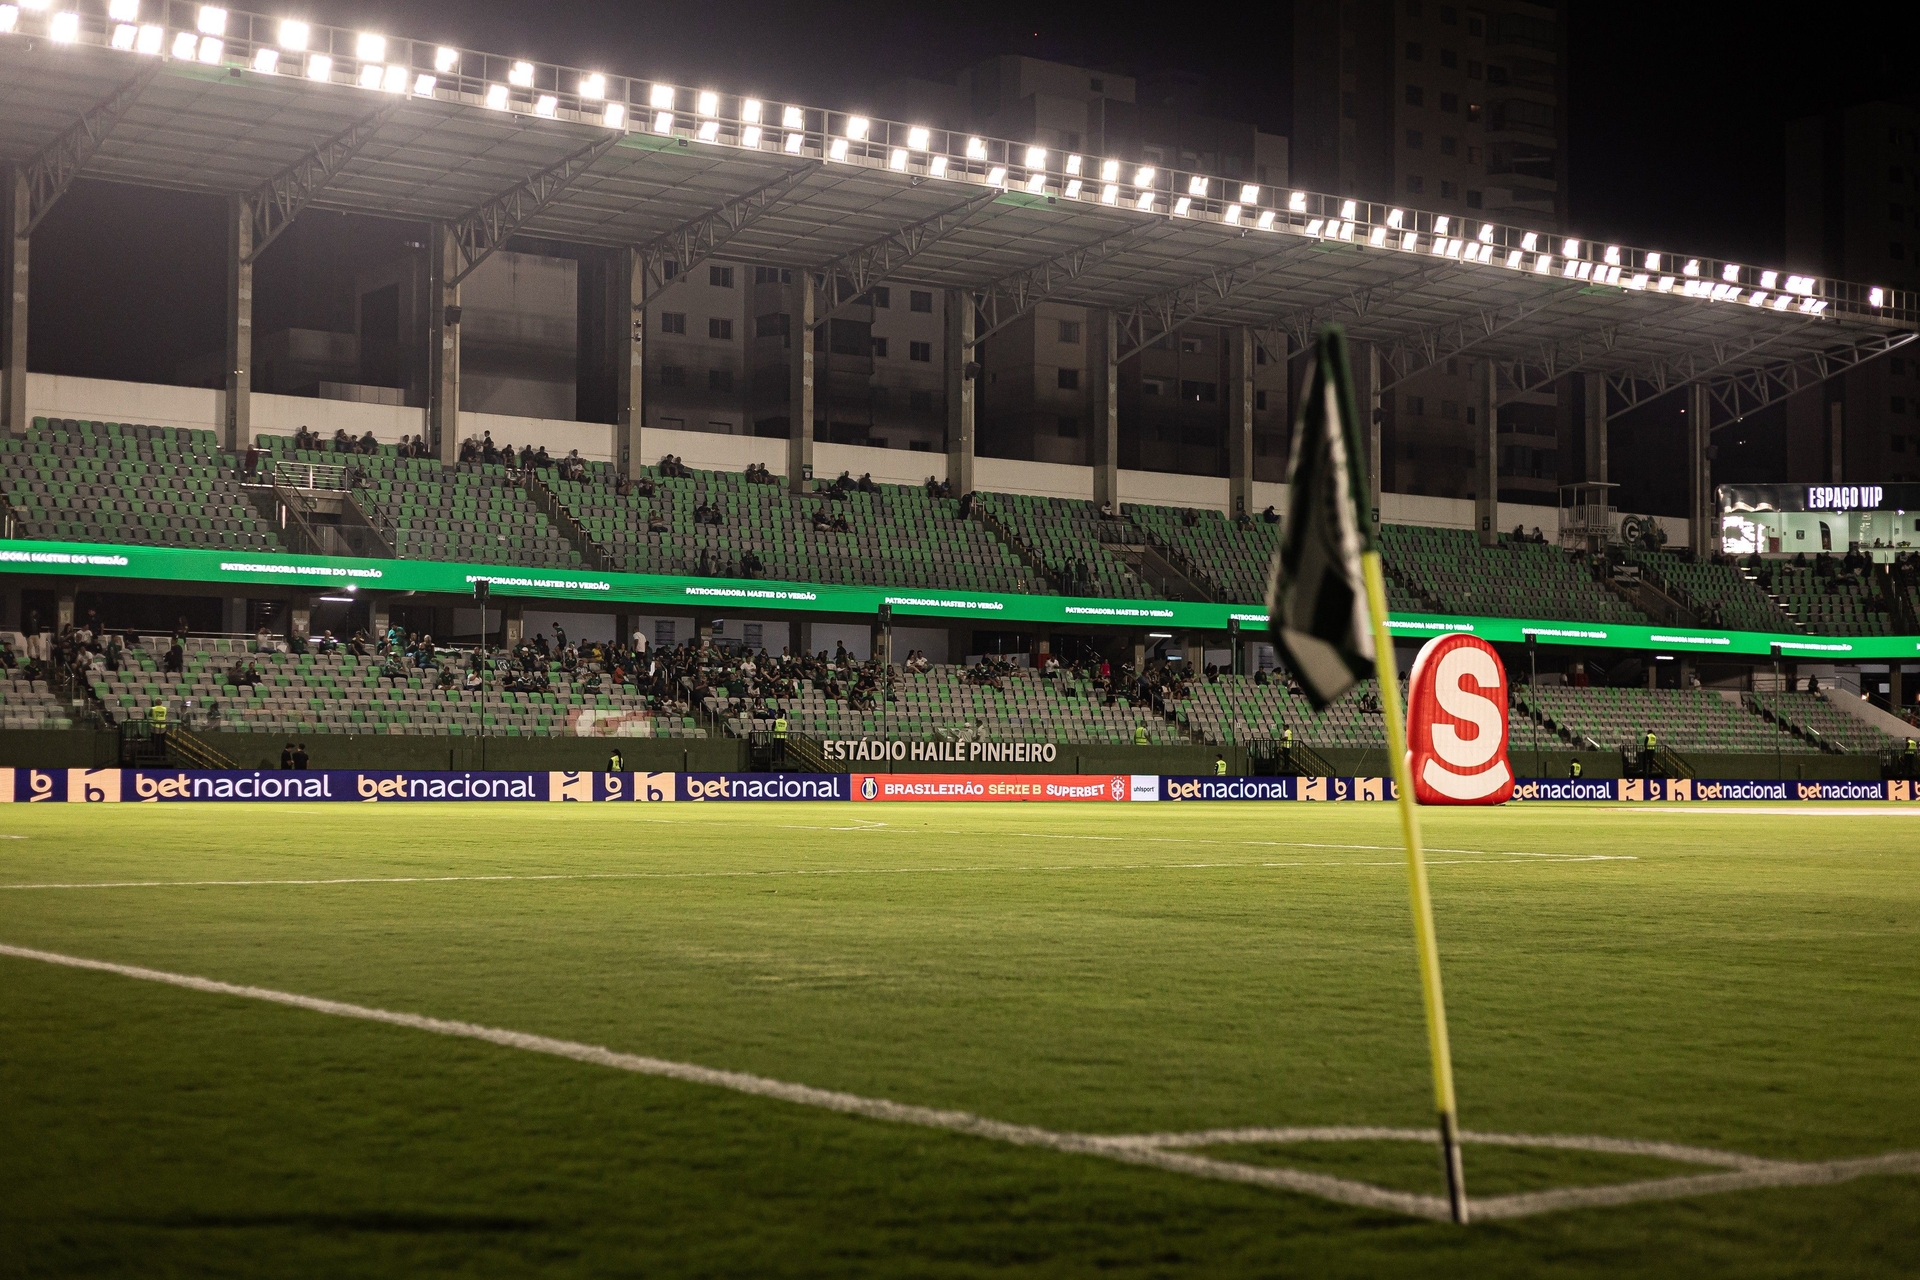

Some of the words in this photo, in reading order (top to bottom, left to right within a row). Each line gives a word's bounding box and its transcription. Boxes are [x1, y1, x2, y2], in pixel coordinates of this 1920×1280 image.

[1809, 486, 1859, 510] ESPAÇO
[1860, 486, 1883, 508] VIP
[32, 552, 71, 564] MASTER
[71, 555, 87, 565] DO
[88, 555, 129, 566] VERDÃO
[220, 562, 296, 574] PATROCINADORA
[297, 566, 332, 576] MASTER
[333, 568, 347, 577] DO
[347, 568, 382, 578] VERDÃO
[533, 579, 564, 588] MASTER
[566, 581, 578, 589] DO
[578, 581, 610, 590] VERDÃO
[685, 587, 747, 598] PATROCINADORA
[747, 590, 775, 599] MASTER
[787, 591, 816, 600] VERDÃO
[885, 597, 940, 607] PATROCINADORA
[940, 600, 966, 608] MASTER
[977, 601, 1004, 610] VERDÃO
[1065, 606, 1115, 616] PATROCINADORA
[1115, 608, 1140, 616] MASTER
[1140, 609, 1150, 617] DO
[1149, 609, 1174, 618] VERDÃO
[1231, 613, 1270, 622] PATROCINADO
[1431, 646, 1503, 768] S
[823, 736, 906, 761] ESTÁDIO
[911, 738, 966, 762] HAILÉ
[969, 742, 1057, 763] PINHEIRO
[136, 772, 332, 802] betnacional
[357, 773, 536, 802] betnacional
[686, 775, 841, 801] betnacional
[884, 781, 984, 795] BRASILEIRÃO
[988, 781, 1030, 795] SÉRIE
[1033, 784, 1042, 795] B
[1046, 784, 1105, 798] SUPERBET
[1167, 778, 1288, 801] betnacional
[1697, 781, 1787, 801] betnacional
[1797, 781, 1883, 801] betnacional
